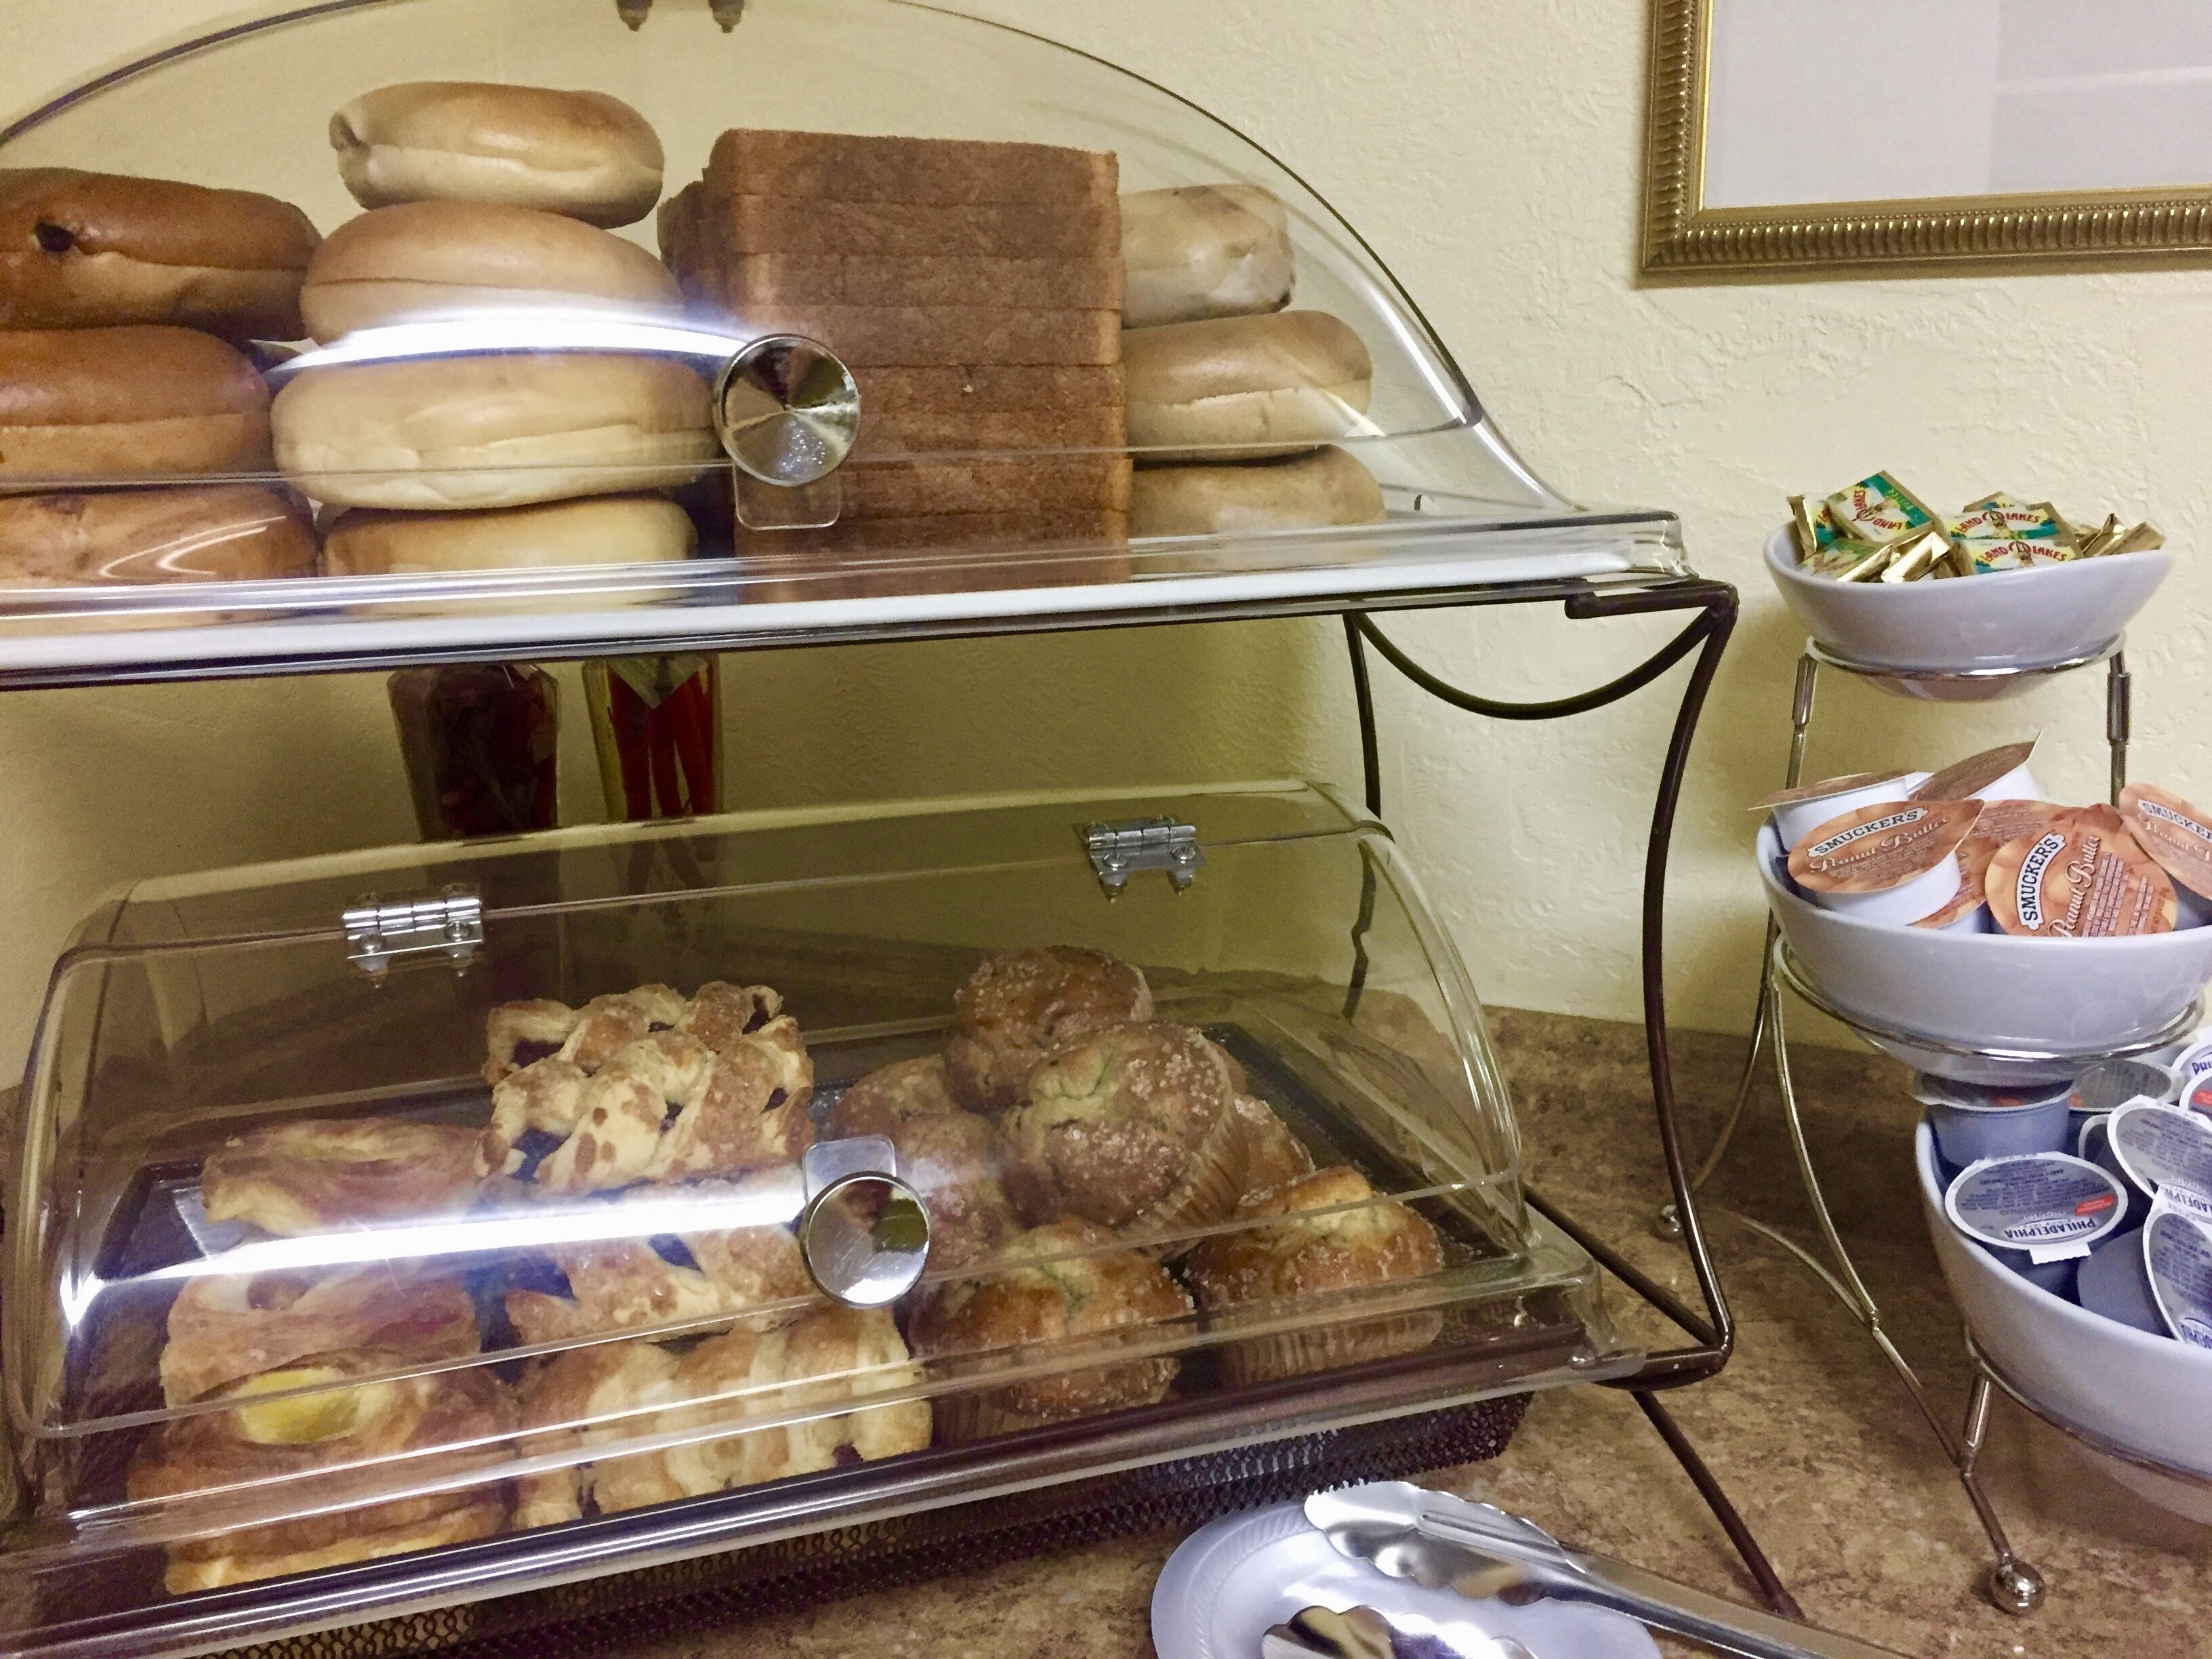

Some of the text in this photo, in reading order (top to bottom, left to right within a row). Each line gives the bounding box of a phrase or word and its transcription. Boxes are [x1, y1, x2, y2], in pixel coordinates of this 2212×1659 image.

[1872, 518, 1903, 530] LAND
[1957, 517, 1983, 533] LAND
[2005, 512, 2040, 523] LAKES
[1980, 546, 2009, 562] LAND
[2032, 546, 2068, 561] LAKES
[1814, 811, 1919, 854] SMUCKER'S
[1809, 847, 1876, 873] Peanut
[2023, 837, 2060, 922] SMUCKER'S
[2048, 834, 2101, 937] Peanut Butter
[2003, 1218, 2097, 1239] PHILADELPHIA
